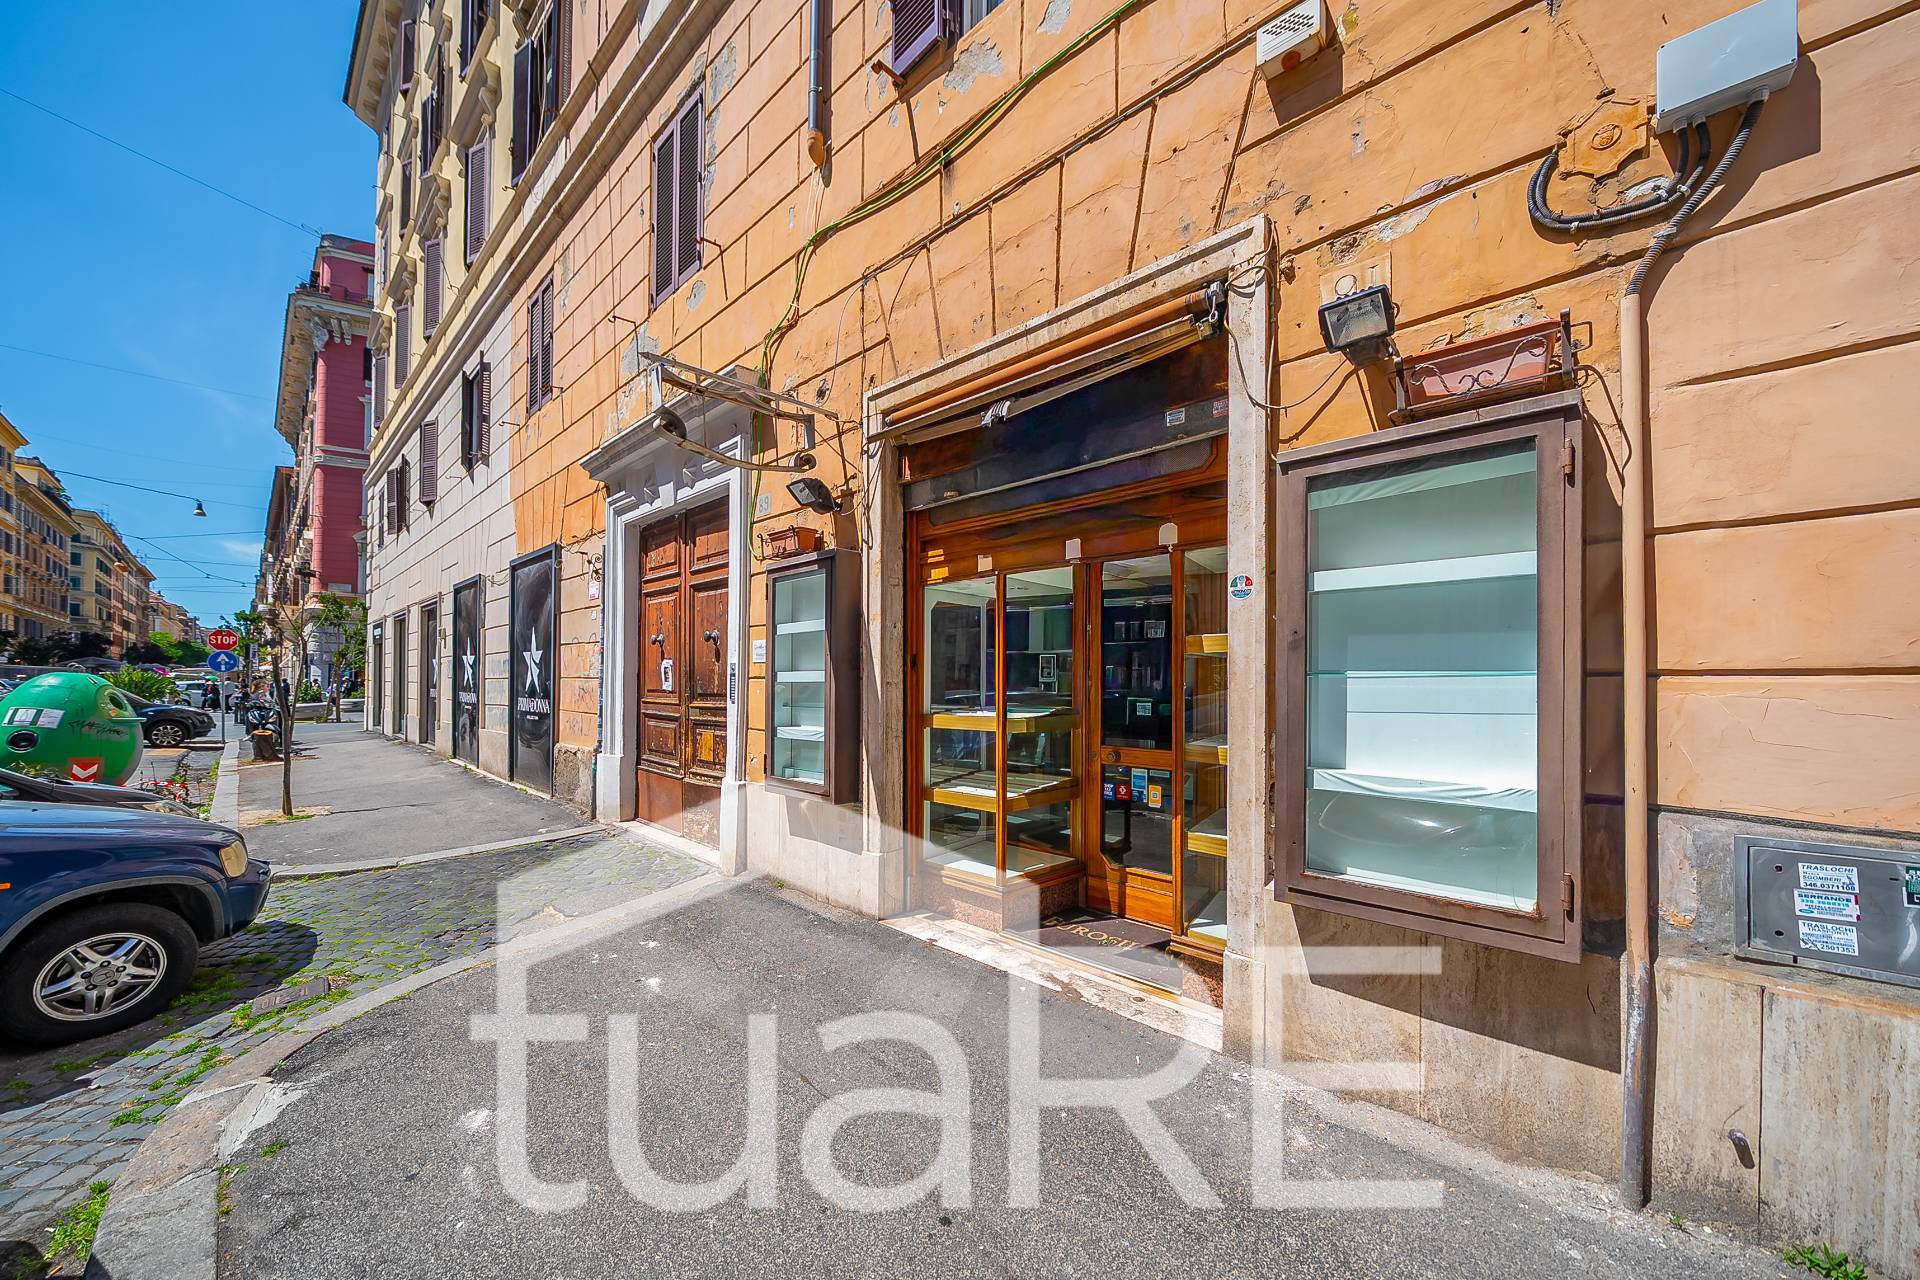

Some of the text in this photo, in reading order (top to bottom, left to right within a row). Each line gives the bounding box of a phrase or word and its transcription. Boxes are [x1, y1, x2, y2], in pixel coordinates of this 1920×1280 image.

[758, 495, 769, 514] 89
[209, 635, 237, 645] STOP
[1801, 864, 1855, 874] TRASLOCHI
[1797, 893, 1852, 903] SERRANDE
[1801, 921, 1855, 933] TRASLOCHI
